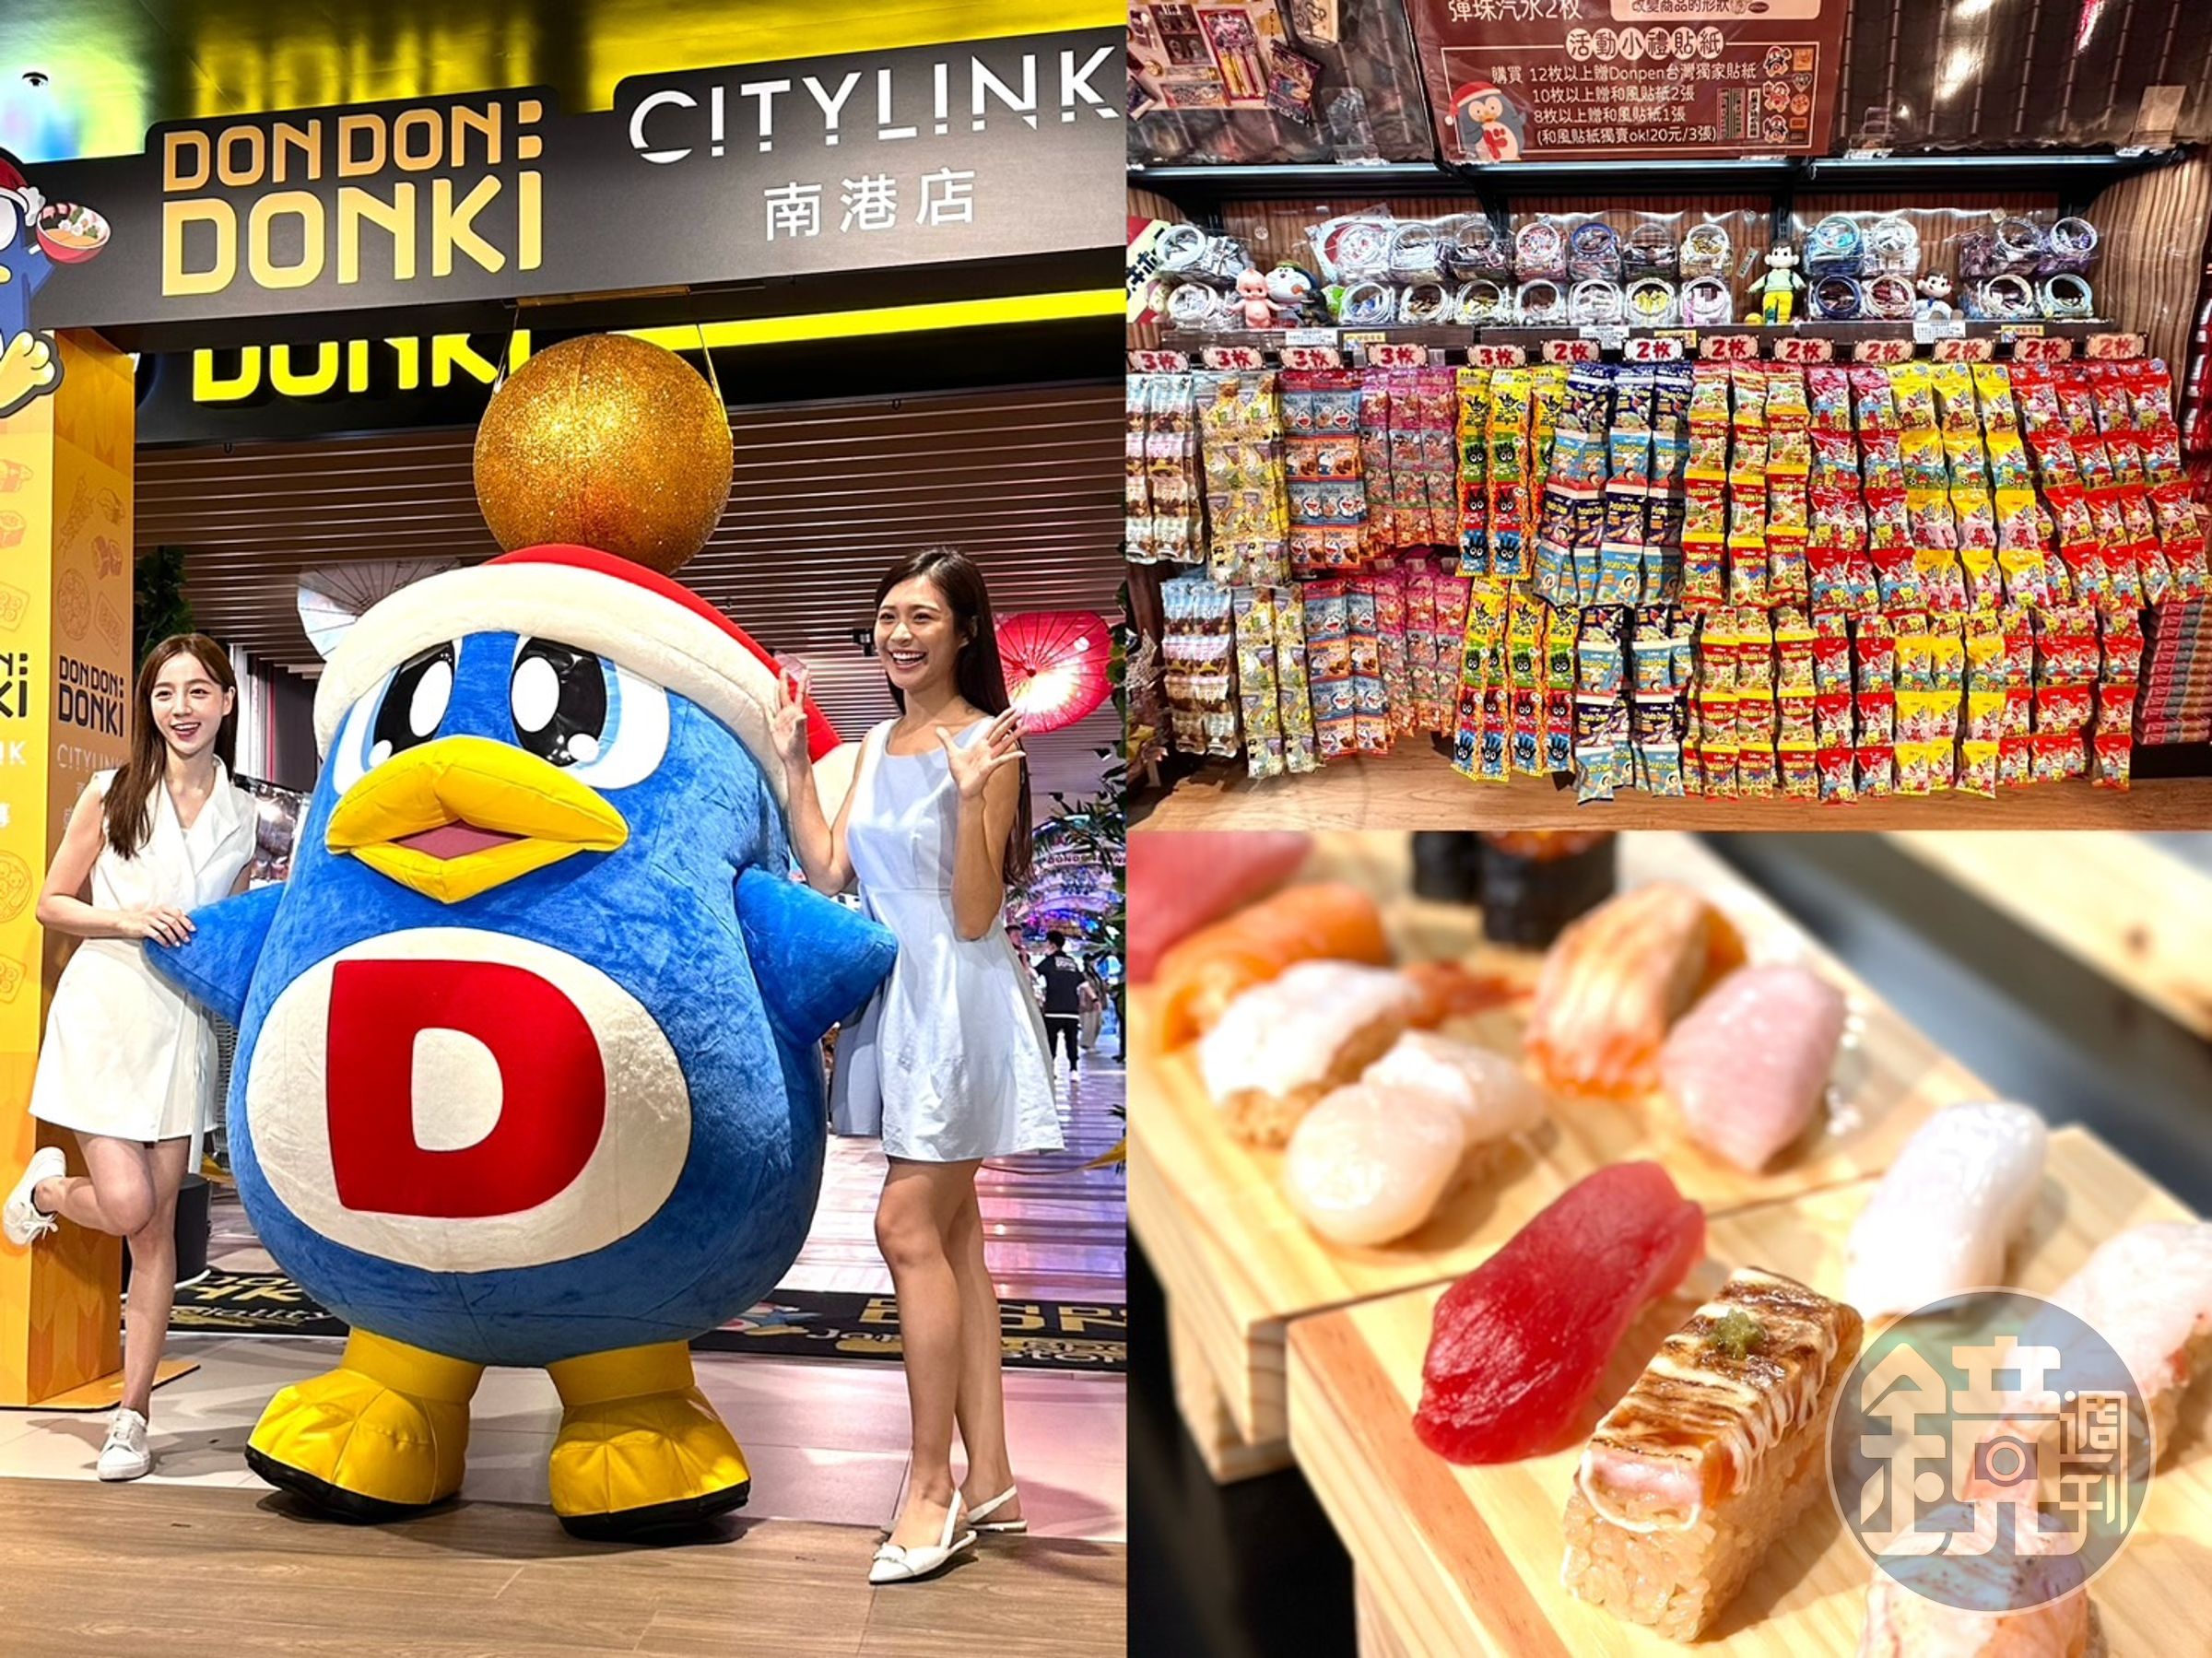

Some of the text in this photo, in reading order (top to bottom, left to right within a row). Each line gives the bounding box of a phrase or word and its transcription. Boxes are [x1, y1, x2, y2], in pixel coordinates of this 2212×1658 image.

[1568, 29, 1723, 58] 活動小禮貼紙
[629, 46, 1121, 164] CITYLINK
[162, 171, 543, 297] DONKI
[763, 167, 975, 241] 南港店
[58, 683, 124, 737] DONKI
[326, 959, 606, 1218] D
